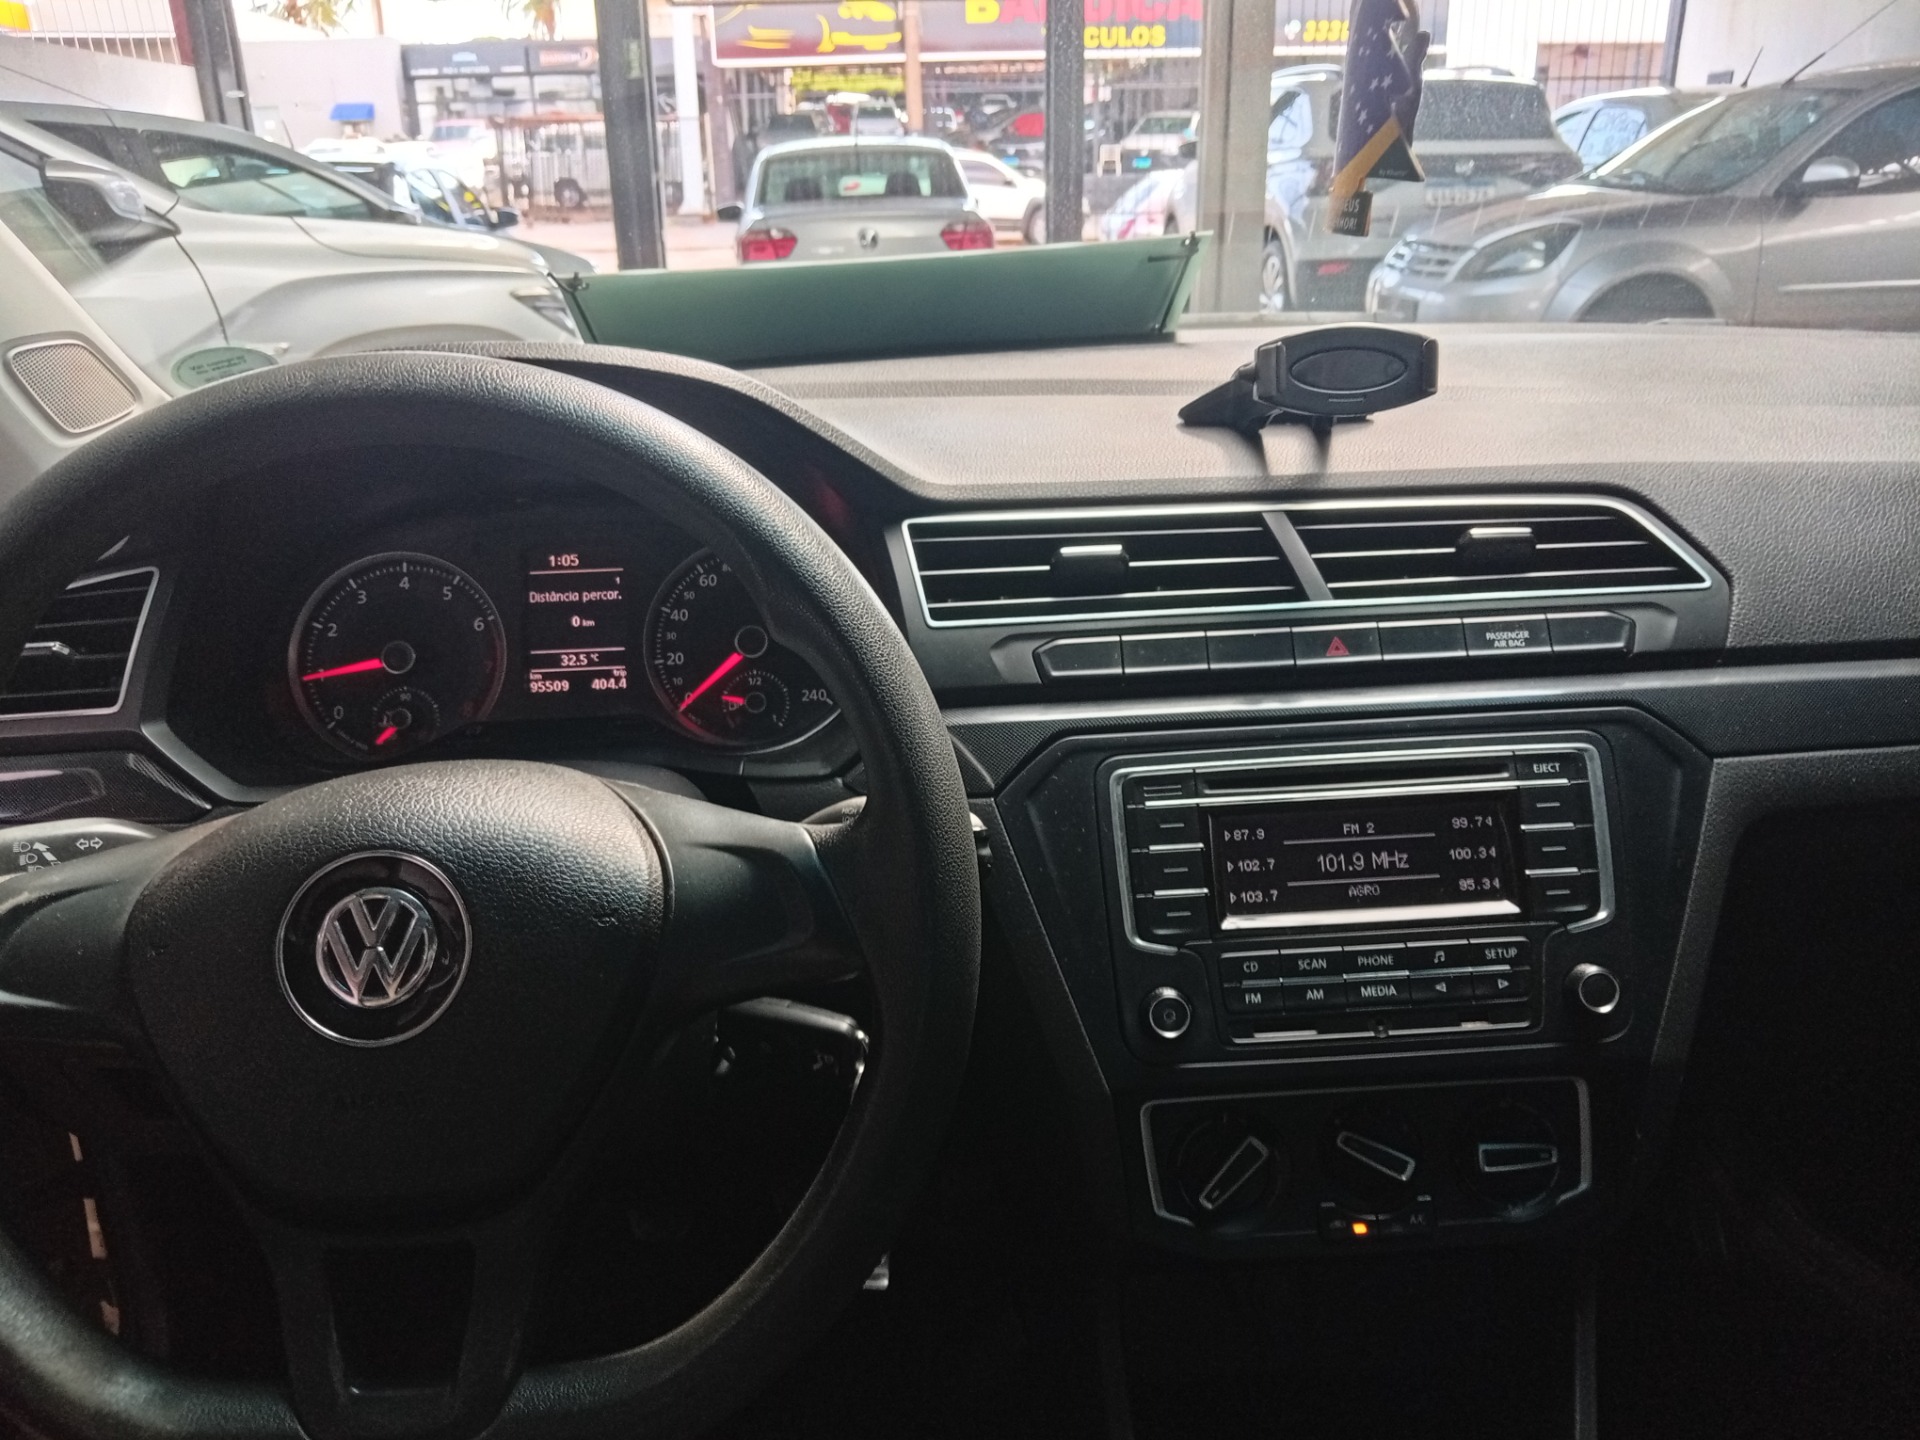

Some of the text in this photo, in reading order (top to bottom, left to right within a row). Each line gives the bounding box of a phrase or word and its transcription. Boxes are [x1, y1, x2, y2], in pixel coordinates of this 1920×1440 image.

[549, 553, 580, 567] 1:05
[398, 576, 410, 590] 4
[699, 574, 718, 587] 60
[356, 590, 367, 604] 3
[442, 586, 452, 600] 5
[529, 590, 622, 603] Distância percor.
[684, 591, 695, 600] 50
[571, 615, 595, 627] 0 km
[670, 609, 689, 621] 40
[327, 623, 338, 637] 2
[473, 617, 485, 631] 6
[666, 632, 676, 640] 30
[1485, 630, 1530, 640] PASSENGER
[1508, 639, 1525, 647] BAG
[561, 654, 588, 666] 32.5
[666, 653, 684, 665] 20
[613, 669, 628, 678] trip
[530, 680, 570, 693] 95509
[591, 678, 627, 690] 404.4
[748, 677, 761, 686] 1/2
[802, 689, 827, 701] 240
[333, 705, 344, 719] 0
[1532, 762, 1560, 773] EJECT
[1343, 821, 1375, 835] FM 2
[1233, 828, 1265, 842] 87.9
[1238, 858, 1275, 873] 102.7
[1317, 850, 1410, 873] 101.9 MHz
[1240, 890, 1278, 904] 103.7
[1348, 884, 1381, 898] AGRO
[1357, 953, 1395, 967] PHONE
[1484, 947, 1519, 961] SETUP
[1243, 960, 1259, 973] CD
[1297, 958, 1328, 971] SCAN
[1305, 988, 1324, 1001] AM
[1360, 984, 1397, 998] MEDIA
[1244, 992, 1262, 1005] FM
